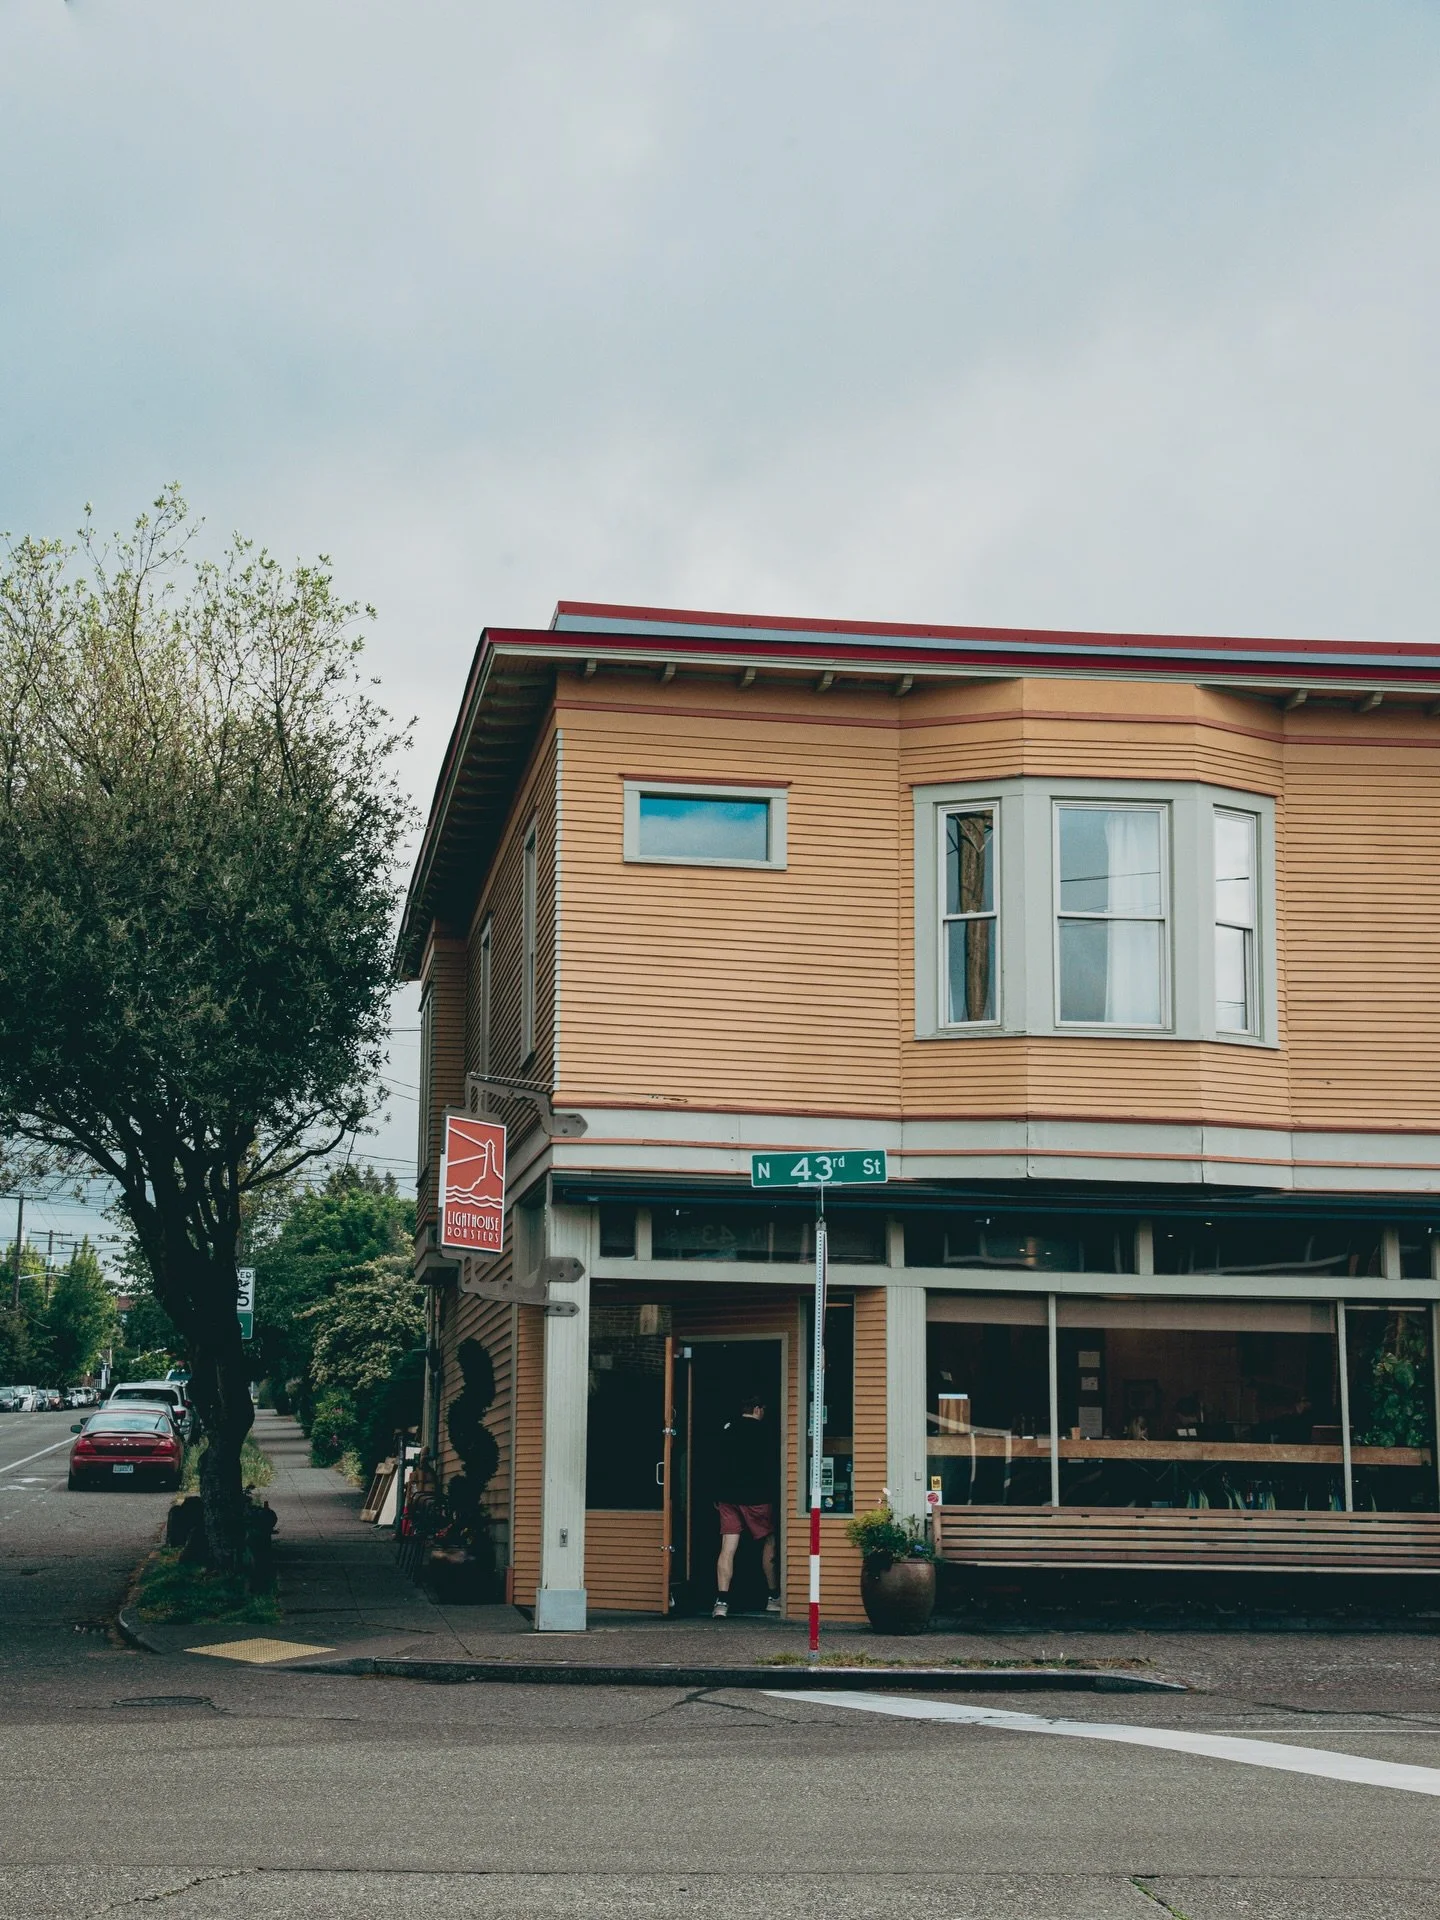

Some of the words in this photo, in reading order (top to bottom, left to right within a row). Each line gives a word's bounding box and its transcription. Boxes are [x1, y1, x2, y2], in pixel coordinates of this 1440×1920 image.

[758, 1162, 771, 1179] N
[790, 1155, 845, 1181] 43rd
[862, 1158, 881, 1175] St
[447, 1211, 499, 1231] LIGHTHOUSE
[447, 1226, 499, 1243] ROASTERS
